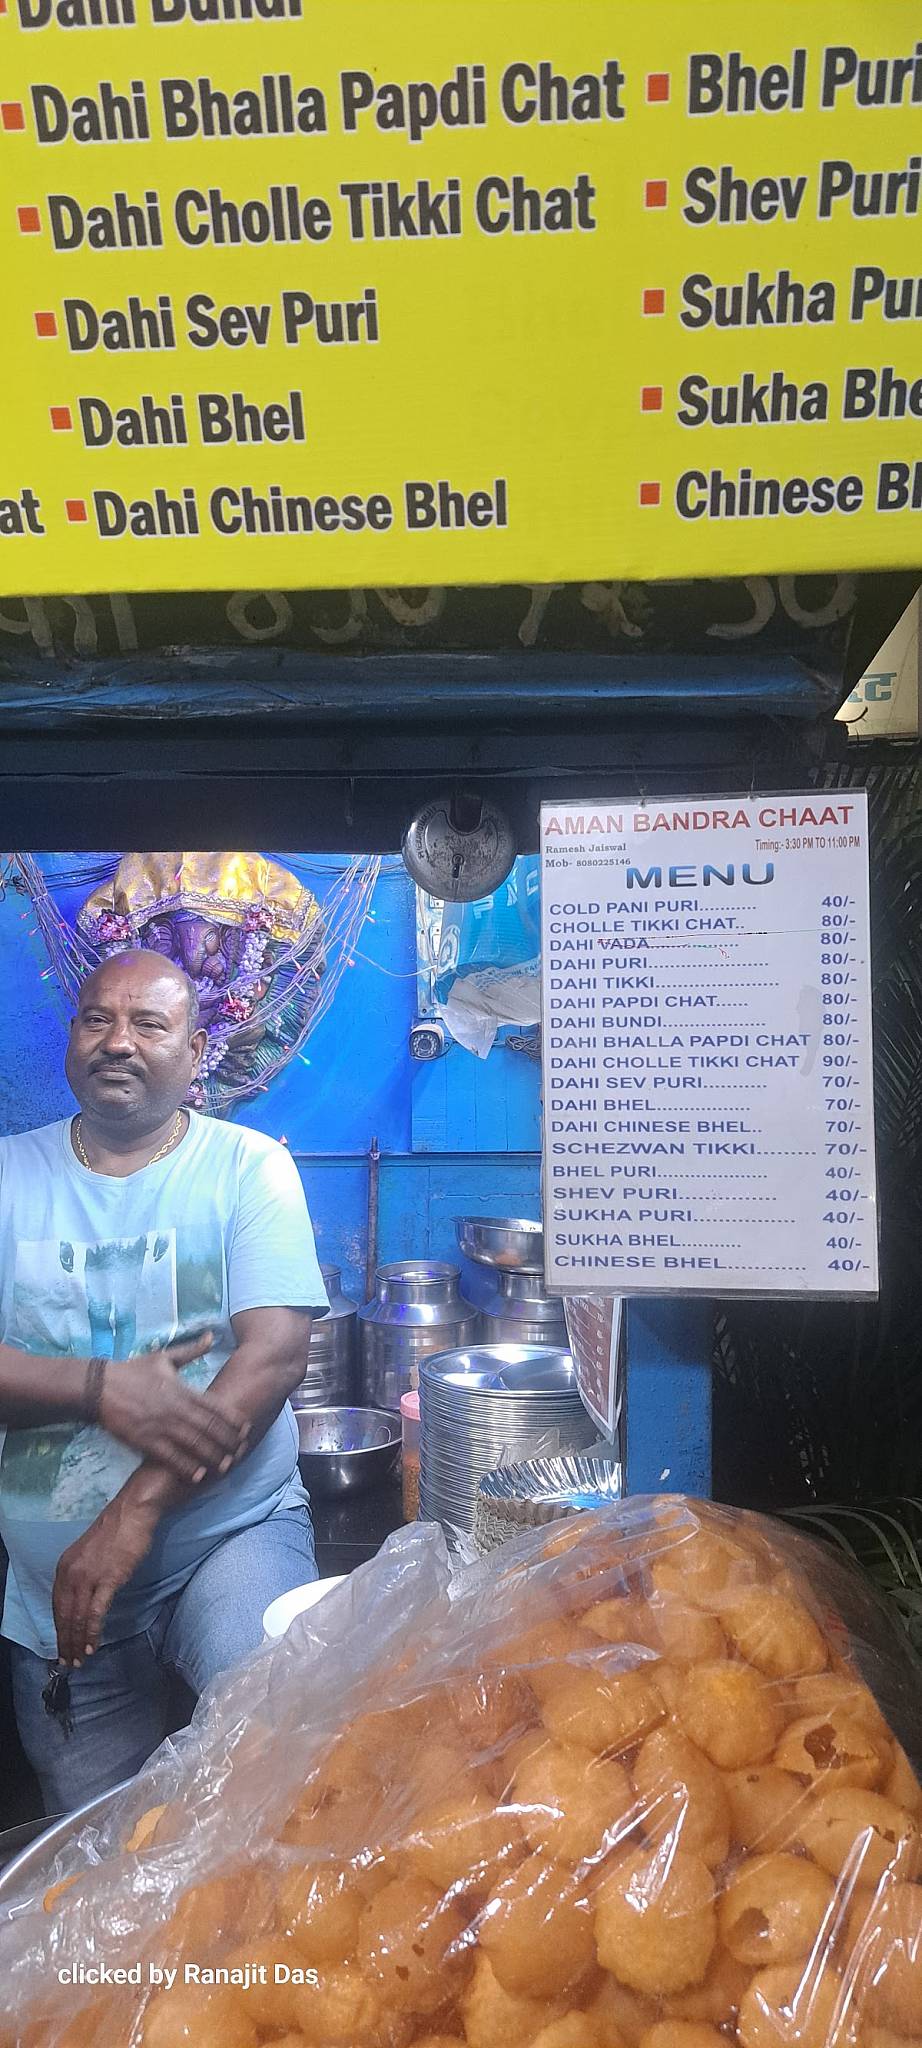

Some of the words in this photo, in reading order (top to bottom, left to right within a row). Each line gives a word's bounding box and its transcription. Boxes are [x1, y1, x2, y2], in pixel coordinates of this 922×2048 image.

[689, 50, 806, 113] Bhel
[822, 43, 922, 106] Puri
[31, 81, 149, 142] Dahi
[162, 75, 326, 137] Bhalla
[341, 66, 485, 140] Papdi
[502, 61, 624, 123] Chat
[684, 167, 807, 223] Shev
[820, 157, 921, 217] Puri
[48, 192, 162, 249] Dahi
[175, 187, 331, 244] Cholle
[341, 180, 461, 237] Tikki
[477, 176, 595, 233] Chat
[681, 271, 835, 327] Sukha
[64, 296, 175, 350] Dahi
[187, 295, 270, 346] Sev
[283, 289, 378, 343] Puri
[678, 373, 827, 425] Sukha
[79, 395, 187, 446] Dahi
[199, 392, 304, 442] Bhel
[677, 469, 863, 518] Chinese
[94, 489, 199, 536] Dahi
[211, 487, 392, 533] Chinese
[406, 480, 507, 528] Bhel
[544, 814, 623, 836] AMAN
[633, 810, 751, 832] BANDRA
[758, 806, 854, 828] CHAAT
[546, 845, 585, 853] Ramesh
[589, 843, 626, 852] Jaiswal
[786, 838, 801, 849] 3:30
[803, 837, 813, 848] PM
[815, 837, 825, 848] TO
[828, 836, 847, 848] 11:00
[849, 836, 860, 847] PM
[546, 859, 572, 867] Mob-
[577, 858, 630, 866] 8080225146
[627, 861, 774, 889] MENU
[550, 903, 600, 915] COLD
[607, 902, 647, 913] PANI
[822, 896, 855, 907] 40/-
[550, 921, 624, 933] CHOLLE
[631, 919, 678, 931] TIKKI
[822, 915, 855, 926] 80/-
[550, 939, 593, 951] DAHI
[821, 932, 856, 944] 80/-
[551, 959, 595, 970] DAHI
[821, 953, 855, 964] 80/-
[551, 978, 596, 989] DAHI
[821, 973, 856, 985] 80/-
[551, 998, 595, 1009] DAHI
[603, 997, 658, 1008] PAPDI
[823, 993, 856, 1004] 80/-
[551, 1017, 595, 1028] DAHI
[823, 1013, 857, 1025] 80/-
[551, 1037, 596, 1048] DAHI
[604, 1036, 684, 1047] BHALLA
[690, 1035, 748, 1046] PAPDI
[756, 1035, 811, 1046] CHAT
[824, 1034, 859, 1045] 80/-
[551, 1058, 595, 1068] DAHI
[603, 1057, 681, 1068] CHOLLE
[688, 1056, 738, 1067] TIKKI
[746, 1056, 799, 1067] CHAT
[823, 1055, 858, 1066] 90/-
[552, 1078, 598, 1088] DAHI
[607, 1077, 646, 1088] SEV
[823, 1076, 859, 1087] 70/-
[552, 1100, 596, 1110] DAHI
[825, 1099, 860, 1110] 70/-
[552, 1121, 597, 1132] DAHI
[604, 1121, 690, 1132] CHINESE
[826, 1121, 861, 1132] 70/-
[553, 1143, 684, 1154] SCHEZWAN
[825, 1144, 867, 1155] 70/-
[553, 1166, 604, 1177] BHEL
[825, 1167, 861, 1178] 40/-
[554, 1188, 614, 1199] SHEV
[826, 1190, 867, 1201] 40/-
[554, 1209, 632, 1221] SUKHA
[823, 1212, 864, 1223] 40/-
[555, 1234, 623, 1245] SUKHA
[827, 1237, 861, 1249] 40/-
[555, 1256, 656, 1267] CHINESE
[828, 1260, 869, 1271] 40/-
